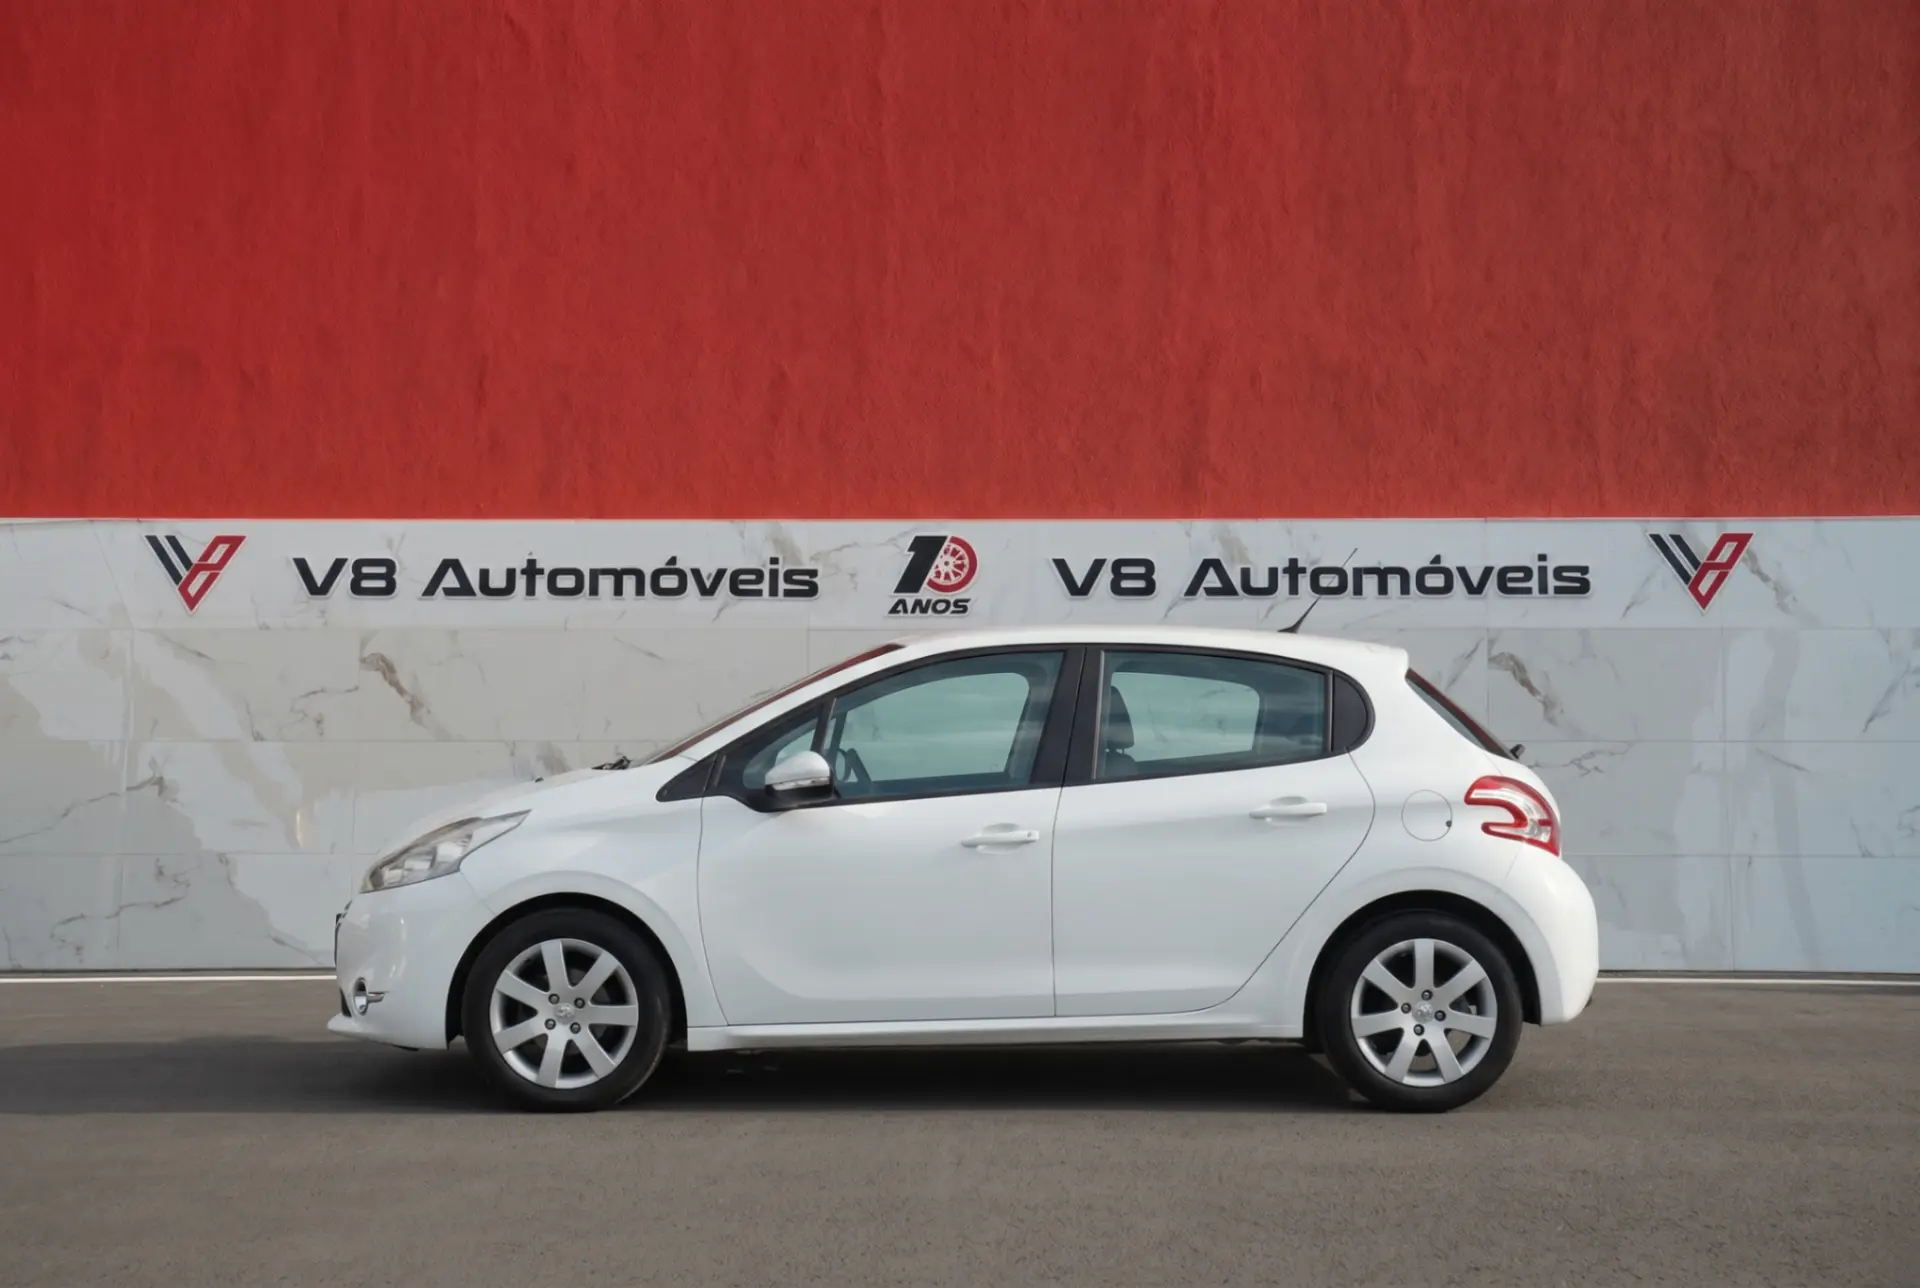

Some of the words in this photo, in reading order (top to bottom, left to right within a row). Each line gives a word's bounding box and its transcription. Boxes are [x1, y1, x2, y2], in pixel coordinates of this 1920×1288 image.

[292, 557, 397, 597] V8
[420, 555, 819, 598] Automóveis
[1051, 557, 1157, 597] V8
[1183, 553, 1591, 597] Automóveis
[888, 598, 971, 615] ANOS
